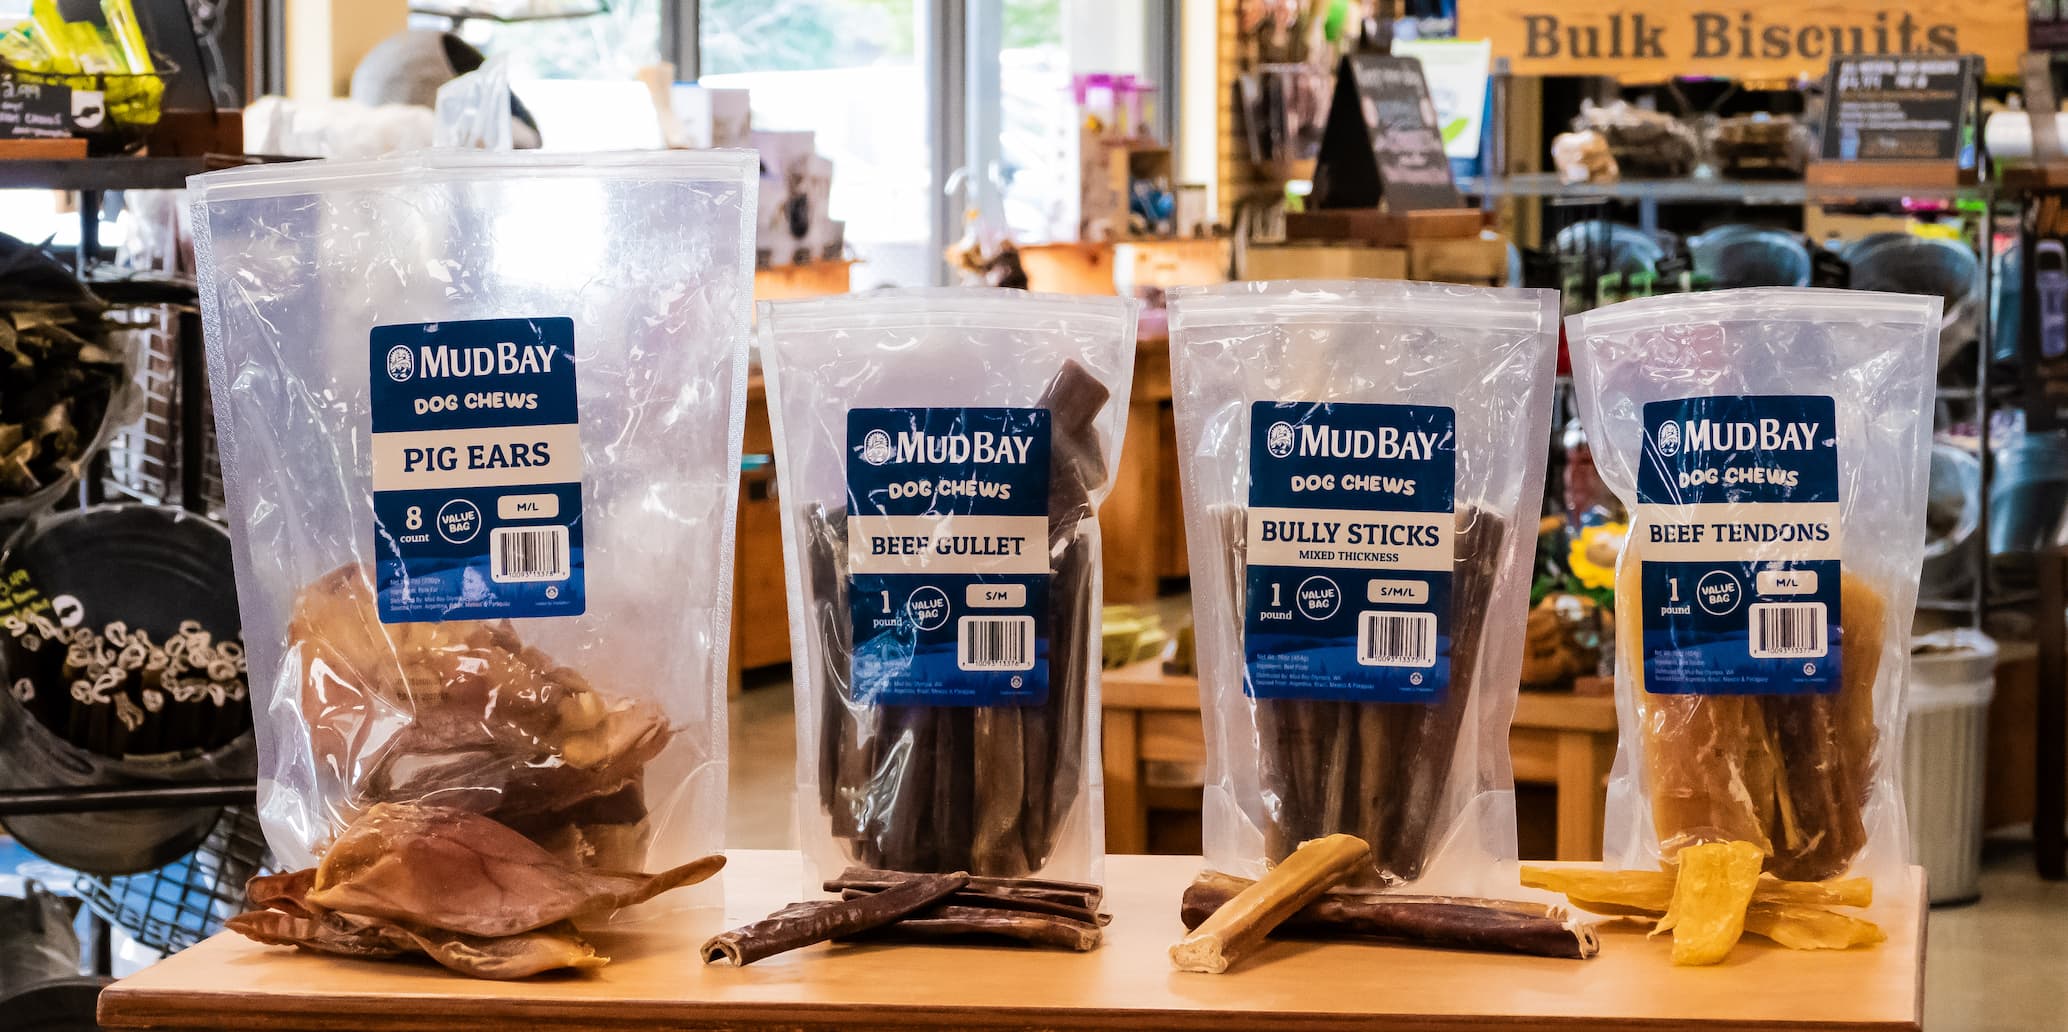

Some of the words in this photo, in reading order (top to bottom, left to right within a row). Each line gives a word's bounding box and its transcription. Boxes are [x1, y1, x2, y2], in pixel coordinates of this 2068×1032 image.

[1523, 13, 1668, 59] Bulk
[1692, 12, 1959, 58] Biscuits
[414, 395, 458, 415] DOG
[464, 391, 538, 409] CHEWS
[404, 447, 458, 472] PIG
[468, 442, 551, 470] EARS
[1679, 468, 1718, 489] DOG
[1724, 467, 1799, 487] CHEWS
[888, 480, 932, 499] DOG
[938, 480, 1012, 500] CHEWS
[1291, 474, 1335, 493] DOG
[1341, 474, 1416, 496] CHEWS
[517, 503, 540, 511] M/L
[405, 506, 423, 530] 8
[442, 511, 475, 524] VALUE
[449, 522, 471, 534] BAG
[1261, 520, 1341, 544] BULLY
[1347, 523, 1440, 547] STICKS
[1649, 524, 1705, 543] BEEF
[1712, 522, 1830, 543] TENDONS
[400, 534, 430, 544] count
[871, 536, 929, 555] BEEF
[935, 536, 1025, 555] GULLET
[1299, 550, 1335, 561] MIXED
[1338, 551, 1399, 562] THICKNESS
[1776, 578, 1799, 587] M/L
[1271, 583, 1281, 607] 1
[1302, 588, 1335, 601] VALUE
[1380, 587, 1415, 598] S/M/L
[1669, 578, 1679, 602] 1
[1702, 583, 1735, 596] VALUE
[881, 590, 891, 613] 1
[985, 592, 1008, 601] S/M
[1709, 594, 1730, 605] BAG
[912, 598, 944, 610] VALUE
[1308, 599, 1330, 610] BAG
[1661, 605, 1690, 616] pound
[918, 609, 939, 619] BAG
[1260, 610, 1292, 621] pound
[873, 617, 902, 628] pound
